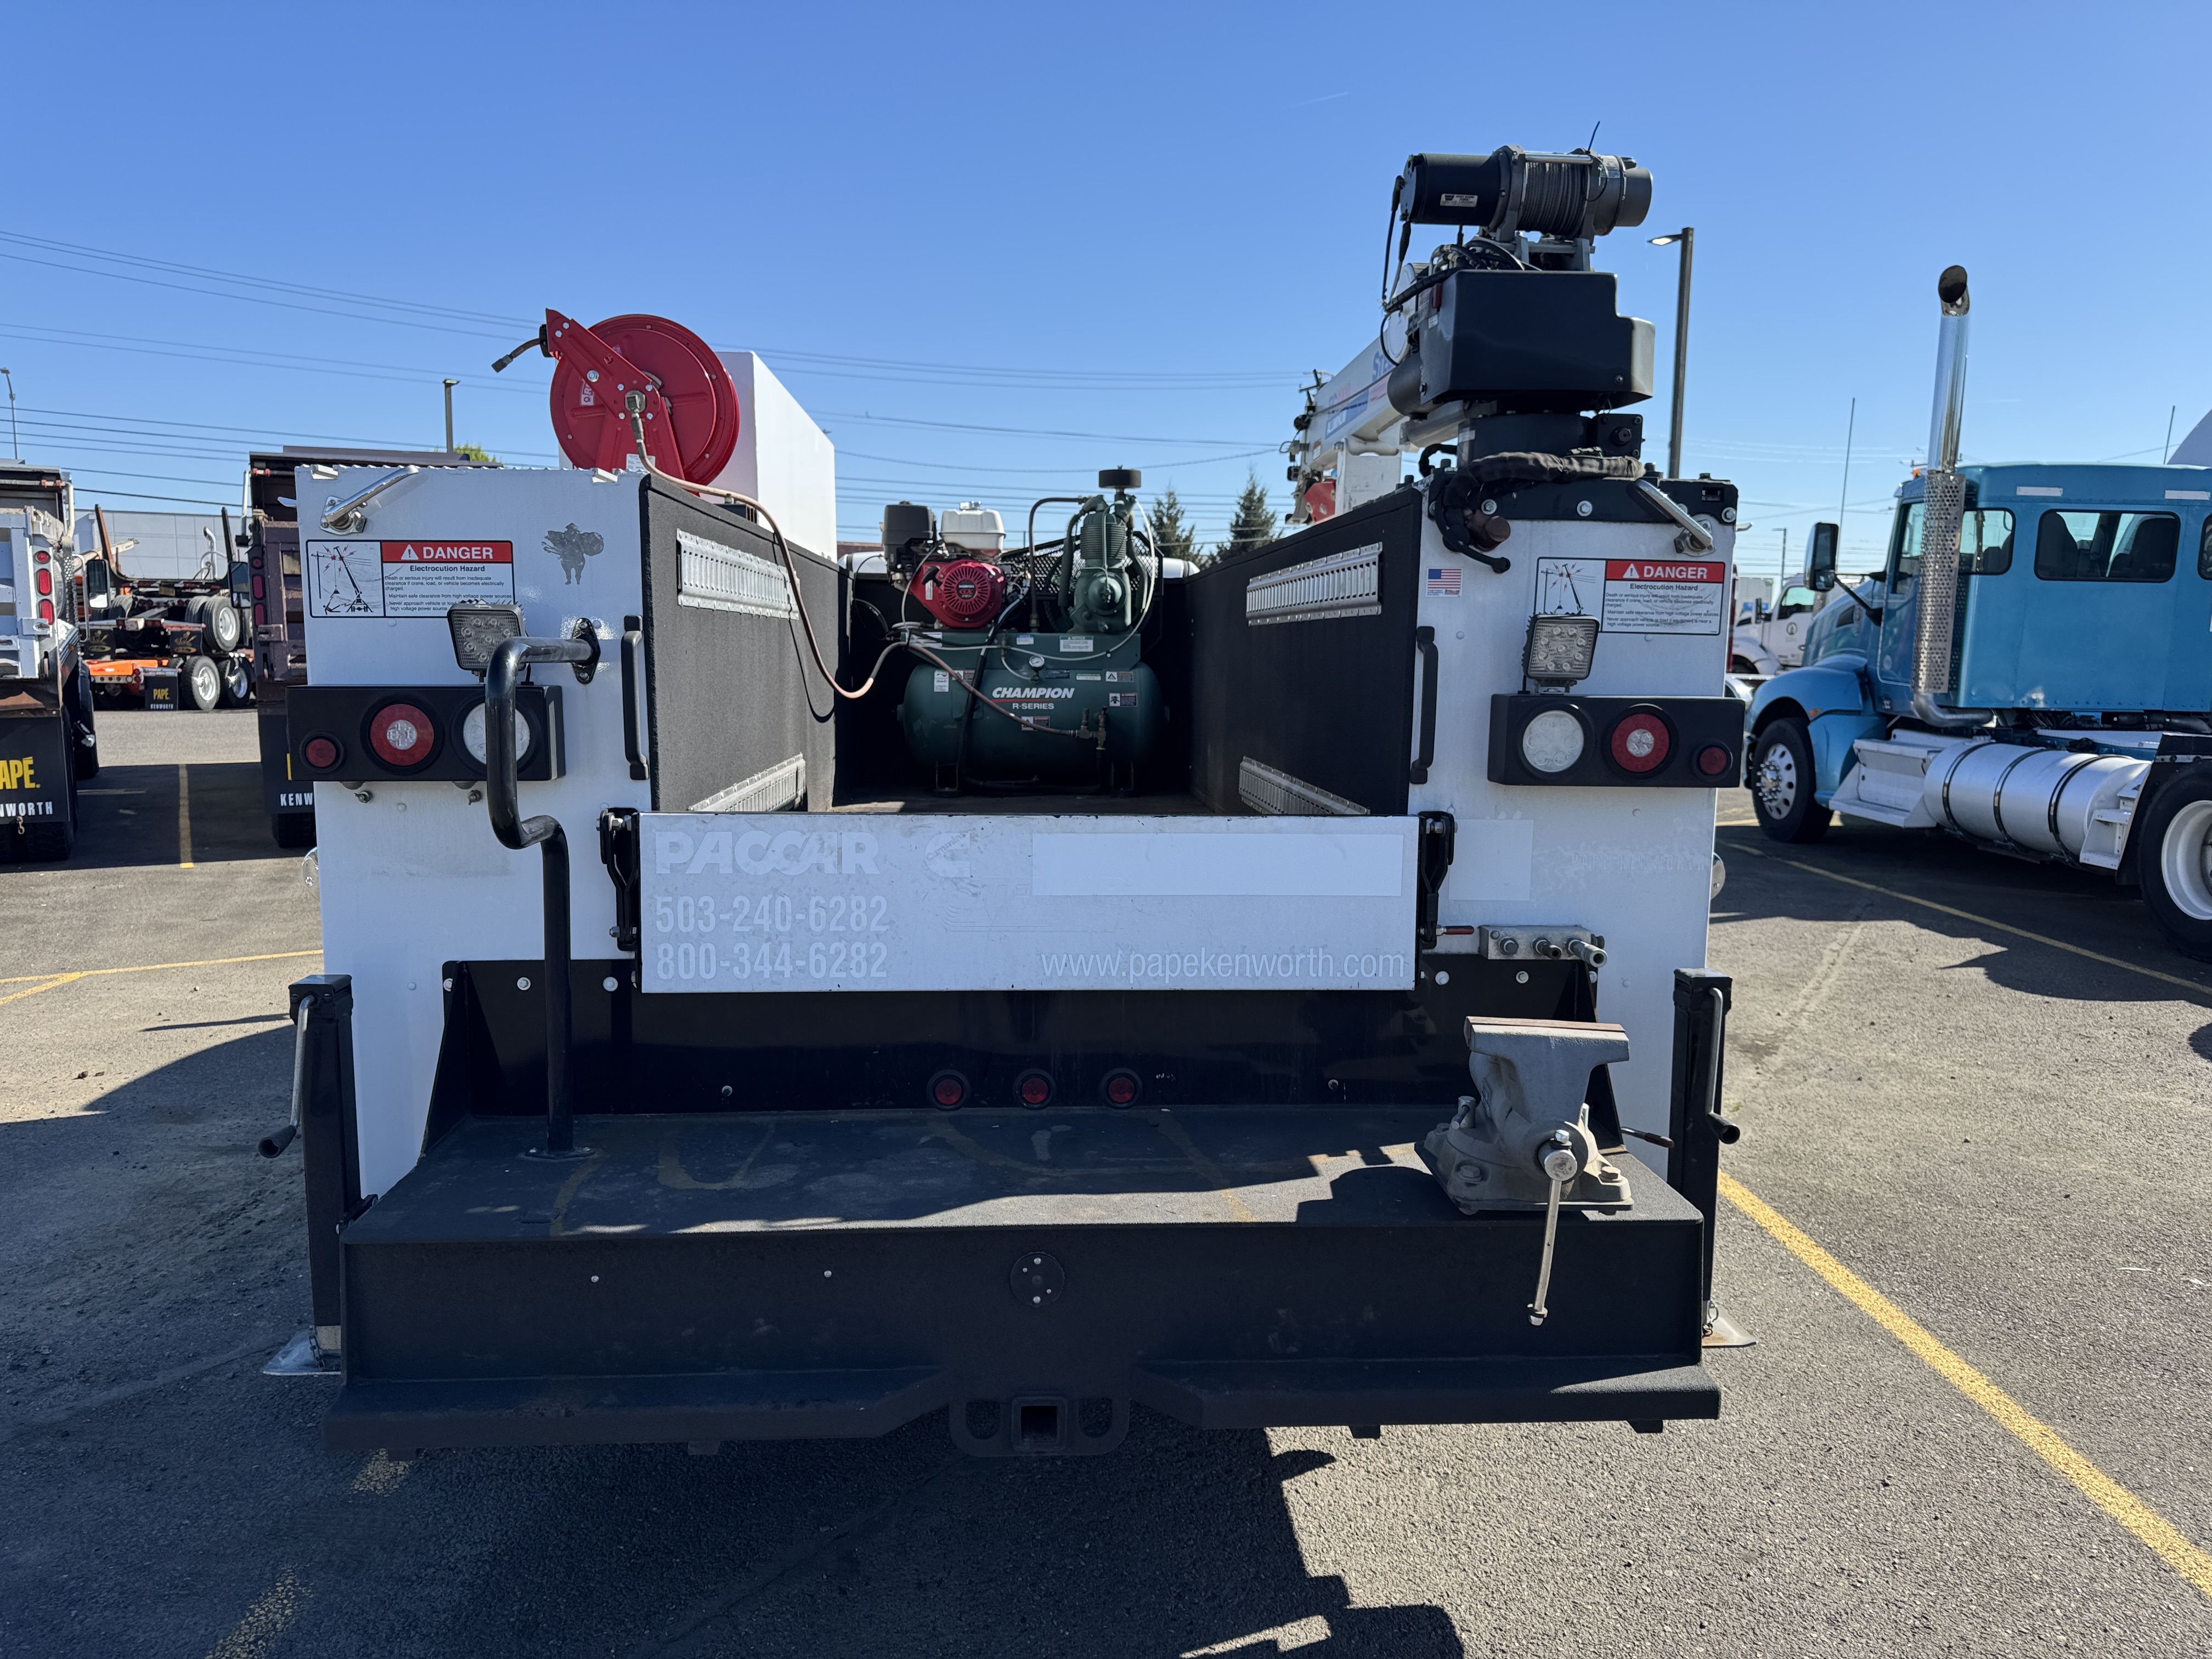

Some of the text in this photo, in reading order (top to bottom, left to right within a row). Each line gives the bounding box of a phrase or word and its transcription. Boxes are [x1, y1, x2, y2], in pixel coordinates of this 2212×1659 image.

[422, 546, 493, 560] DANGER
[1643, 566, 1707, 579] DANGER
[992, 687, 1075, 699] CHAMPION
[655, 830, 880, 876] PACCAR
[656, 895, 887, 933] 503-240-6282
[657, 941, 887, 979] 800-344-6282
[1041, 947, 1405, 984] www.papekenworth.com
